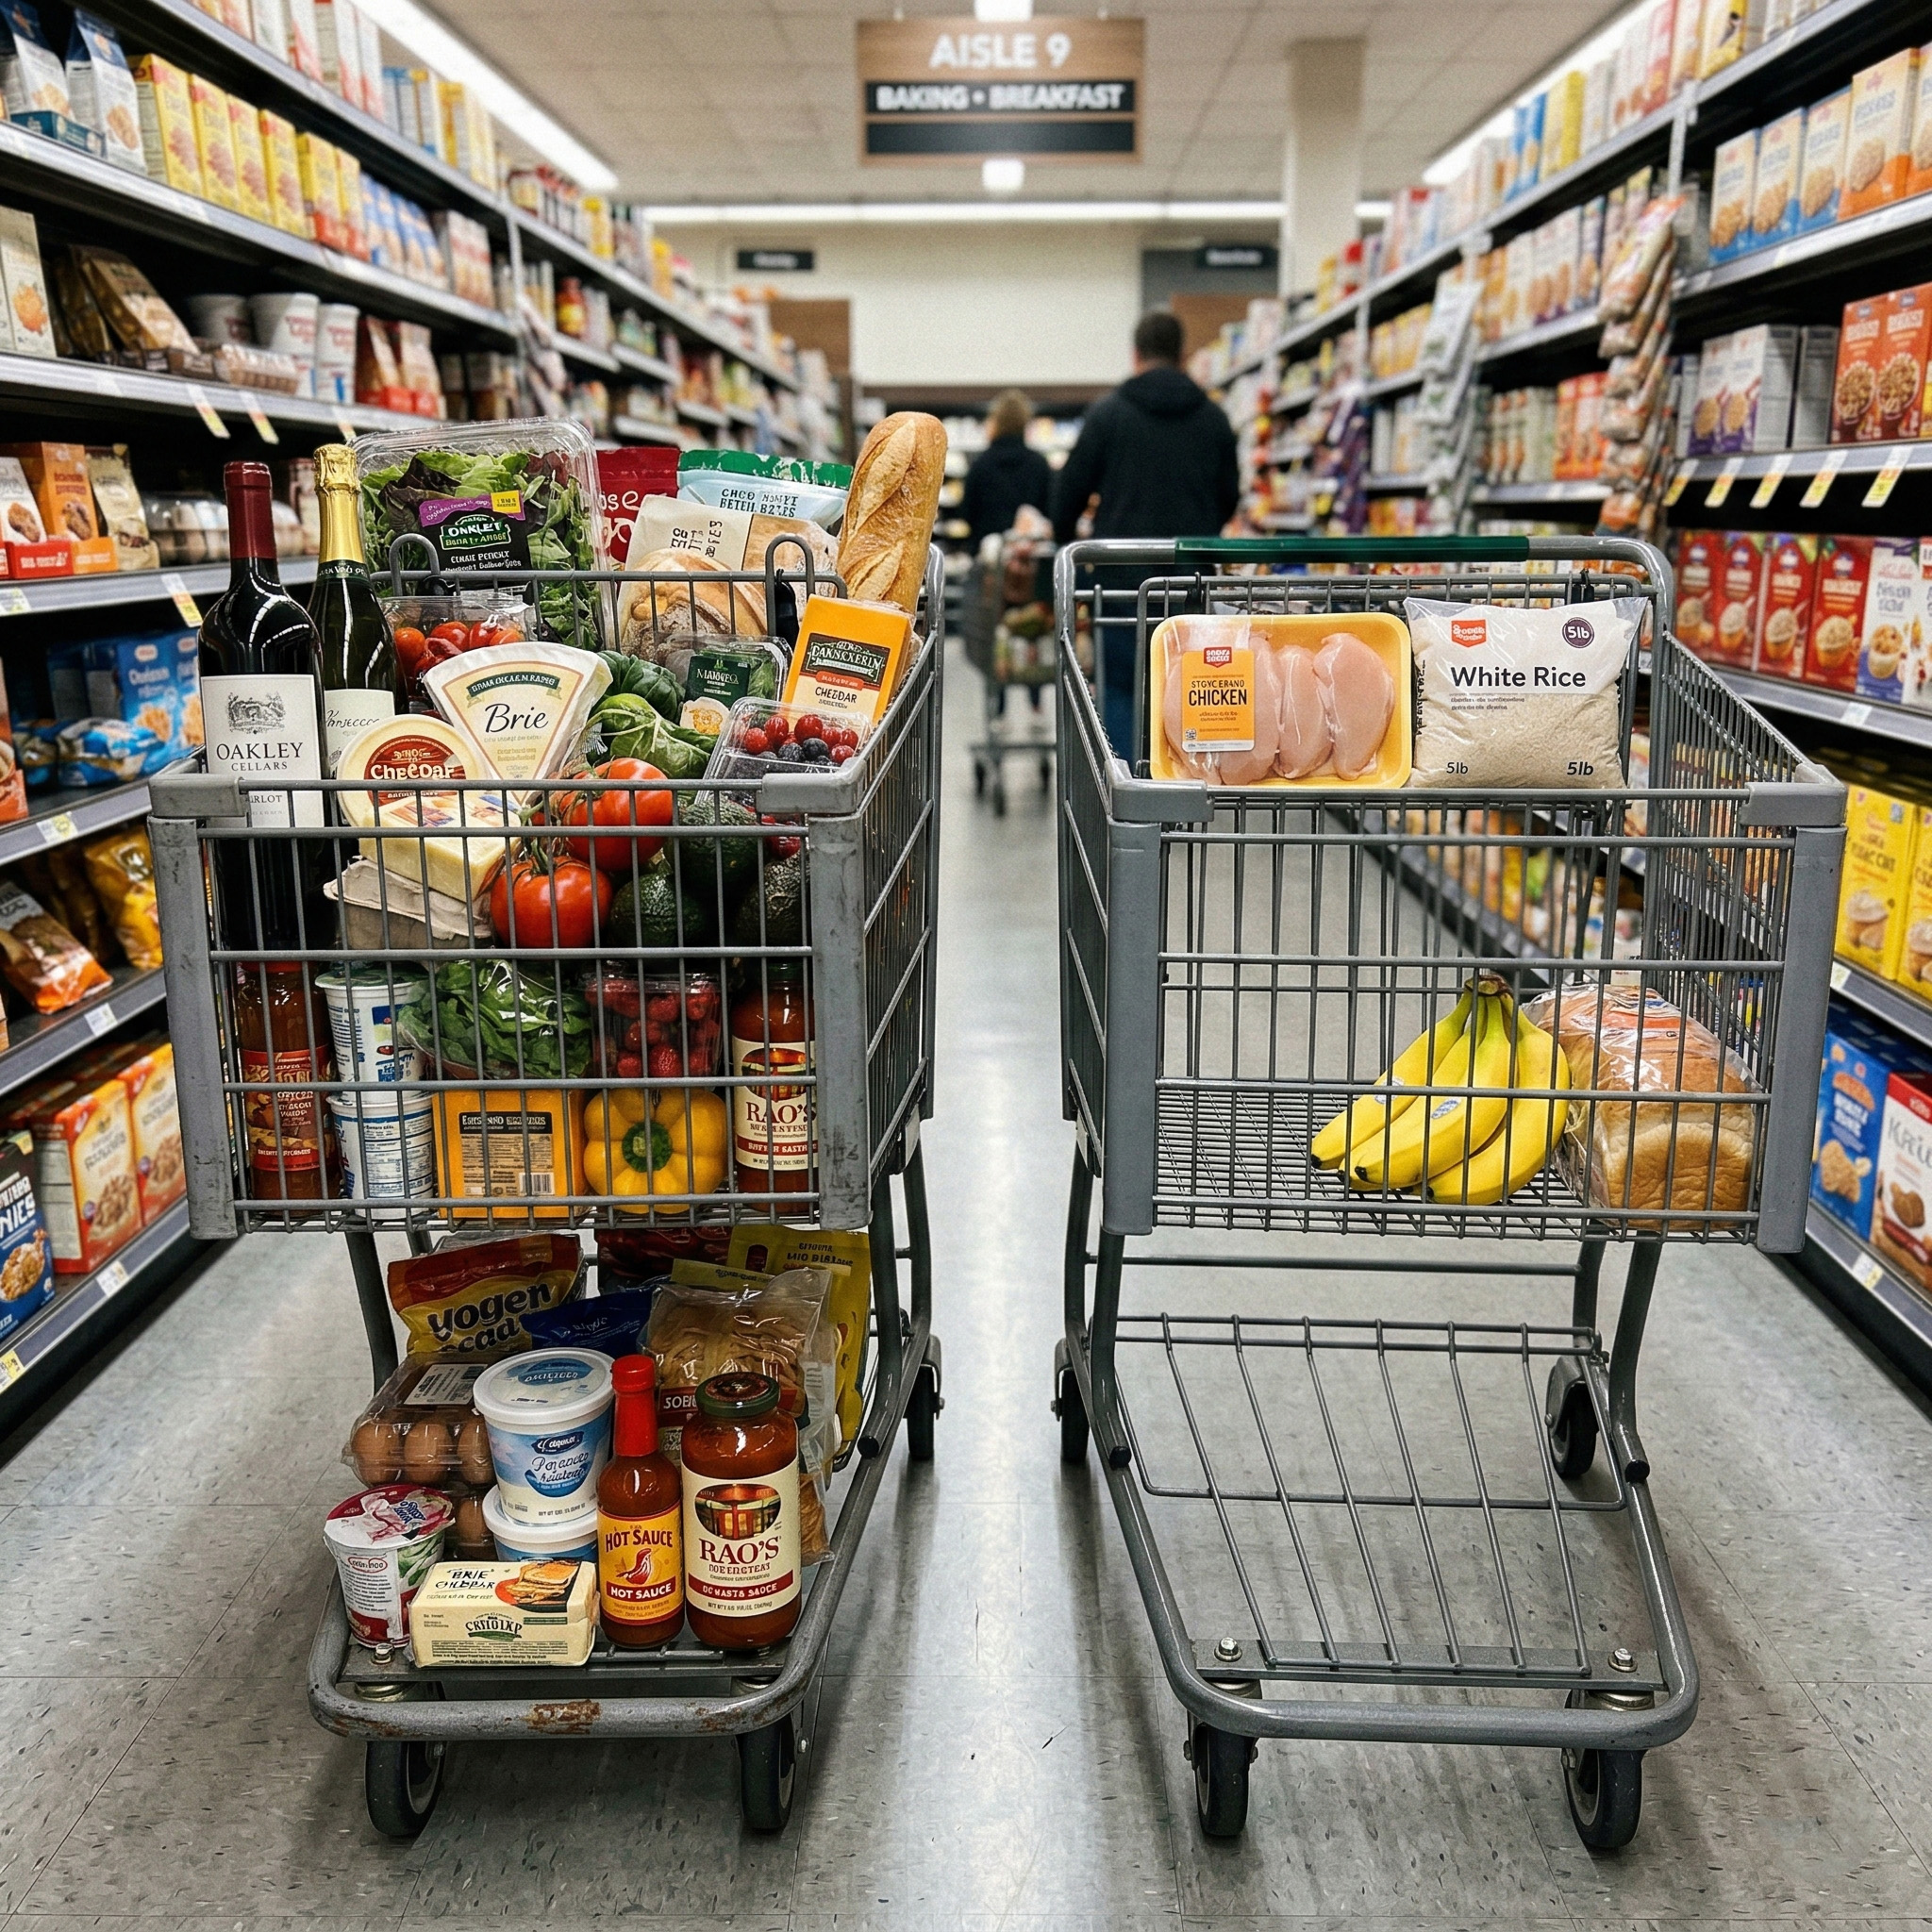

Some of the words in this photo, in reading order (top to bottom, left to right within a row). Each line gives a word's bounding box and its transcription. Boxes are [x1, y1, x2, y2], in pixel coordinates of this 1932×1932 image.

[929, 33, 1037, 69] AISLE
[1045, 32, 1072, 69] 9
[875, 85, 970, 110] BAKING
[989, 83, 1124, 110] BREAKFAST
[1567, 625, 1590, 639] 5lb
[1451, 666, 1526, 687] White
[1534, 666, 1586, 687] Rice
[1189, 689, 1247, 706] CHICKEN
[485, 703, 549, 733] Brie
[216, 741, 304, 760] OAKLEY
[231, 761, 288, 772] CELLARS
[1446, 762, 1469, 774] 5lb
[1567, 761, 1594, 775] 5lb
[606, 1530, 630, 1554] HOT
[633, 1529, 674, 1548] SAUCE
[698, 1536, 779, 1565] RAO'S
[610, 1586, 634, 1599] HOT
[635, 1582, 672, 1599] SAUCE
